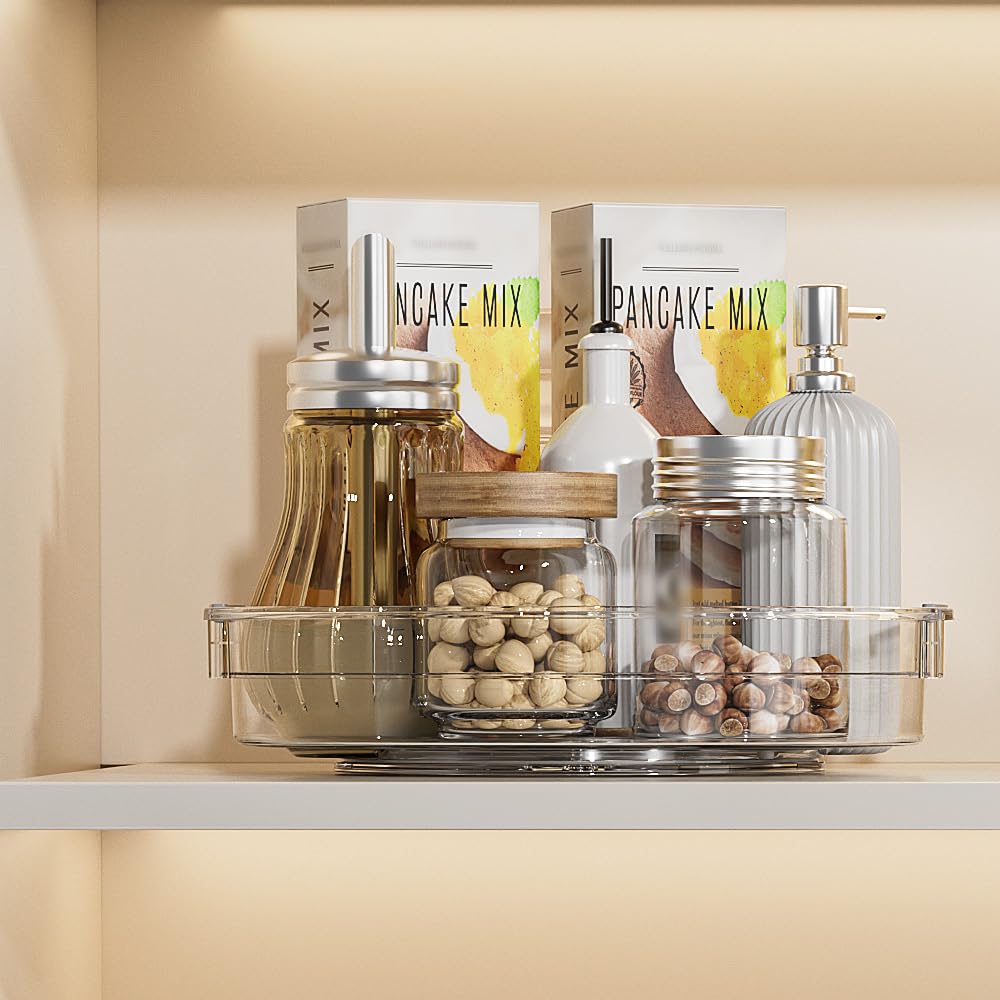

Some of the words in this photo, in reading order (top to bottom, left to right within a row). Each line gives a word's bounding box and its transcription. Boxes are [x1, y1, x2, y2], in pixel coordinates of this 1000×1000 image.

[396, 282, 469, 327] NCAKE
[483, 283, 521, 328] MIX
[612, 285, 715, 330] PANCAKE
[729, 287, 768, 330] MIX
[564, 303, 579, 369] MIX
